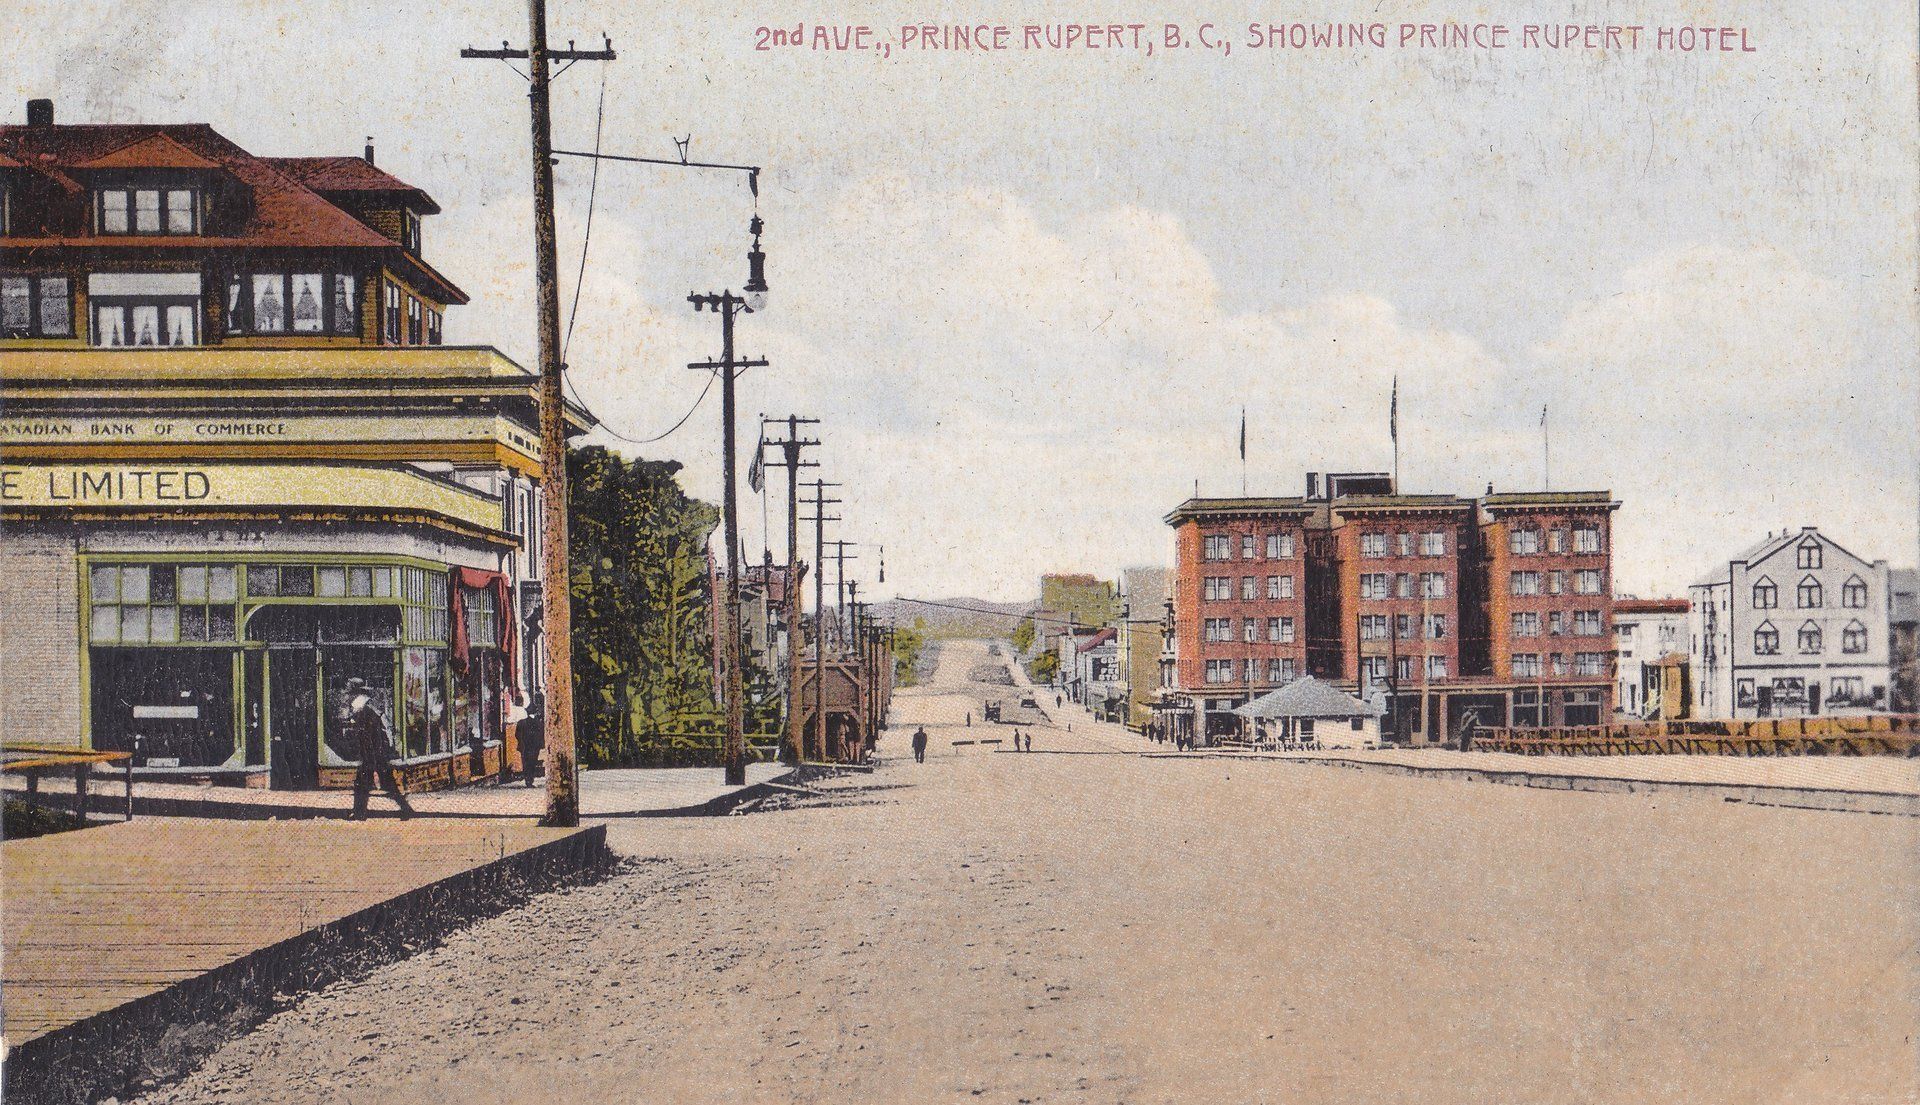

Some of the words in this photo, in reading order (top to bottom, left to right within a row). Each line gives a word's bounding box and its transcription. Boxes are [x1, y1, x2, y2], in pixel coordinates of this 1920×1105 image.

[90, 423, 135, 436] BANK
[154, 423, 174, 436] OF
[195, 423, 287, 436] COMMERCE
